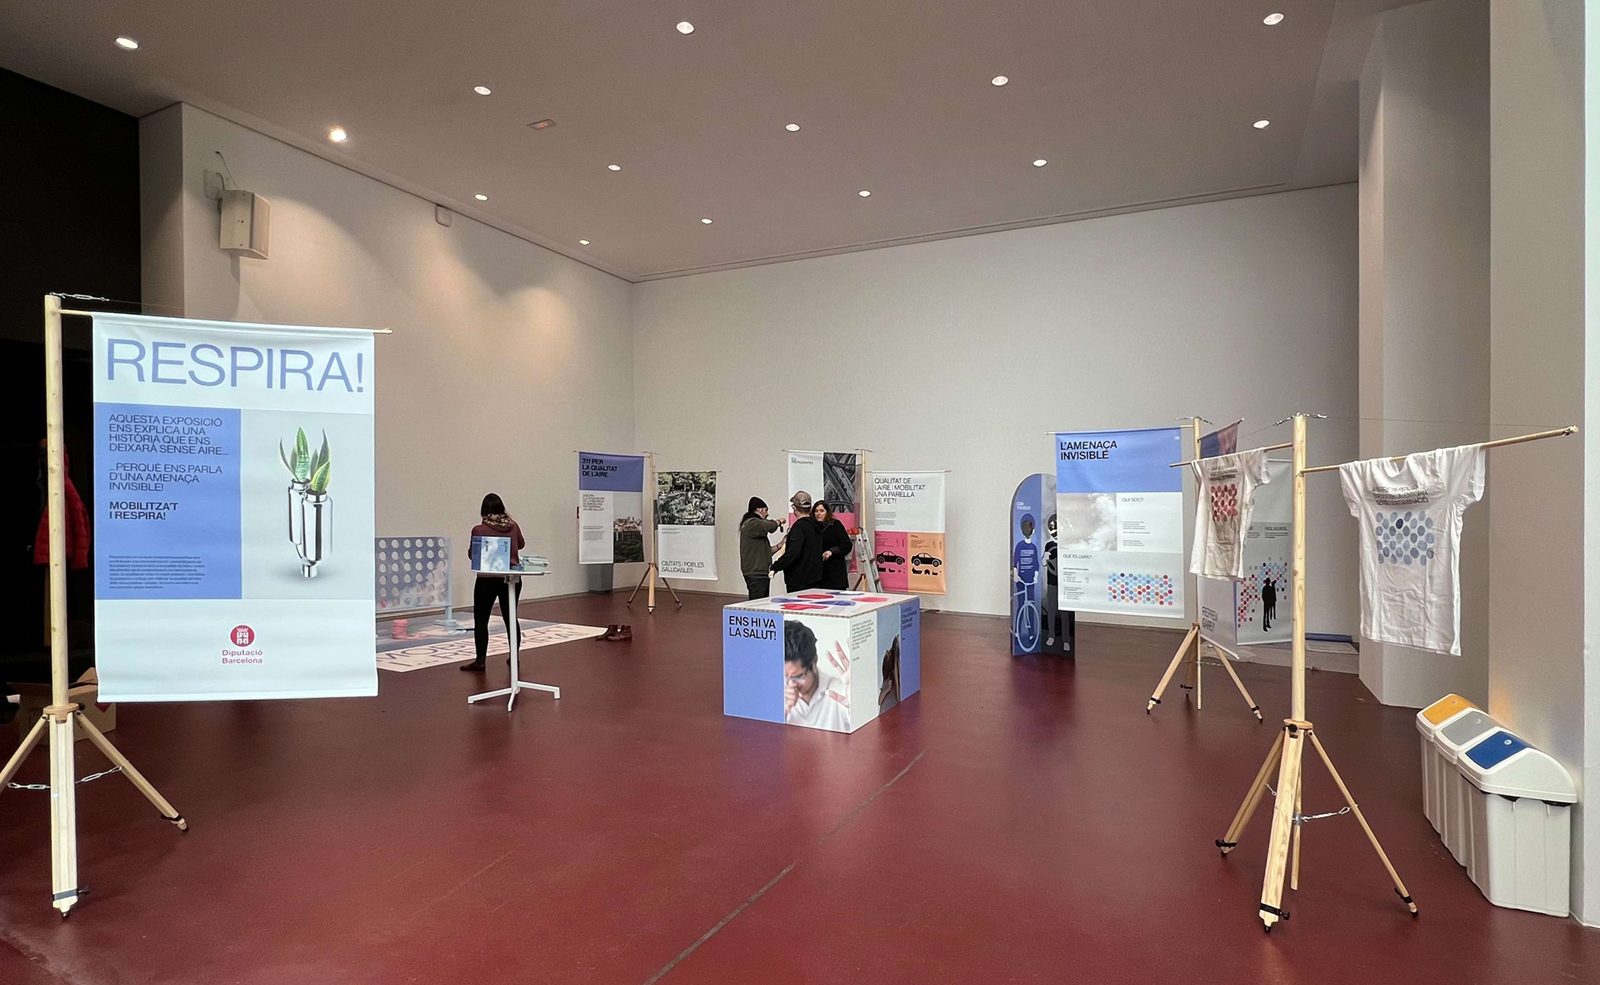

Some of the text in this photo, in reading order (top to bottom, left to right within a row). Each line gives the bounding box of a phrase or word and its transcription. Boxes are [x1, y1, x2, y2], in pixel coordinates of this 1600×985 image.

[107, 338, 364, 393] RESPIRA!
[108, 414, 222, 427] AQUESTA EXPOSICIÓ
[109, 424, 206, 436] ENS EXPLICA UNA
[109, 433, 211, 446] HISTÒRIA QUE ENS
[109, 442, 158, 453] DEIXARÀ
[159, 445, 196, 454] SENSE
[1060, 440, 1117, 452] L'AMENAÇA
[1060, 451, 1109, 460] INVISIBLE
[164, 464, 186, 473] ENS
[188, 465, 222, 474] PARLA
[109, 472, 200, 484] D'UNA AMENAÇA
[109, 482, 164, 491] INVISIBLE!
[109, 501, 178, 511] MOBILITZA'T
[109, 511, 166, 520] I RESPIRA!
[729, 615, 776, 628] ENS HI VA
[729, 627, 776, 640] LA SALUT!
[222, 649, 263, 657] Diputació
